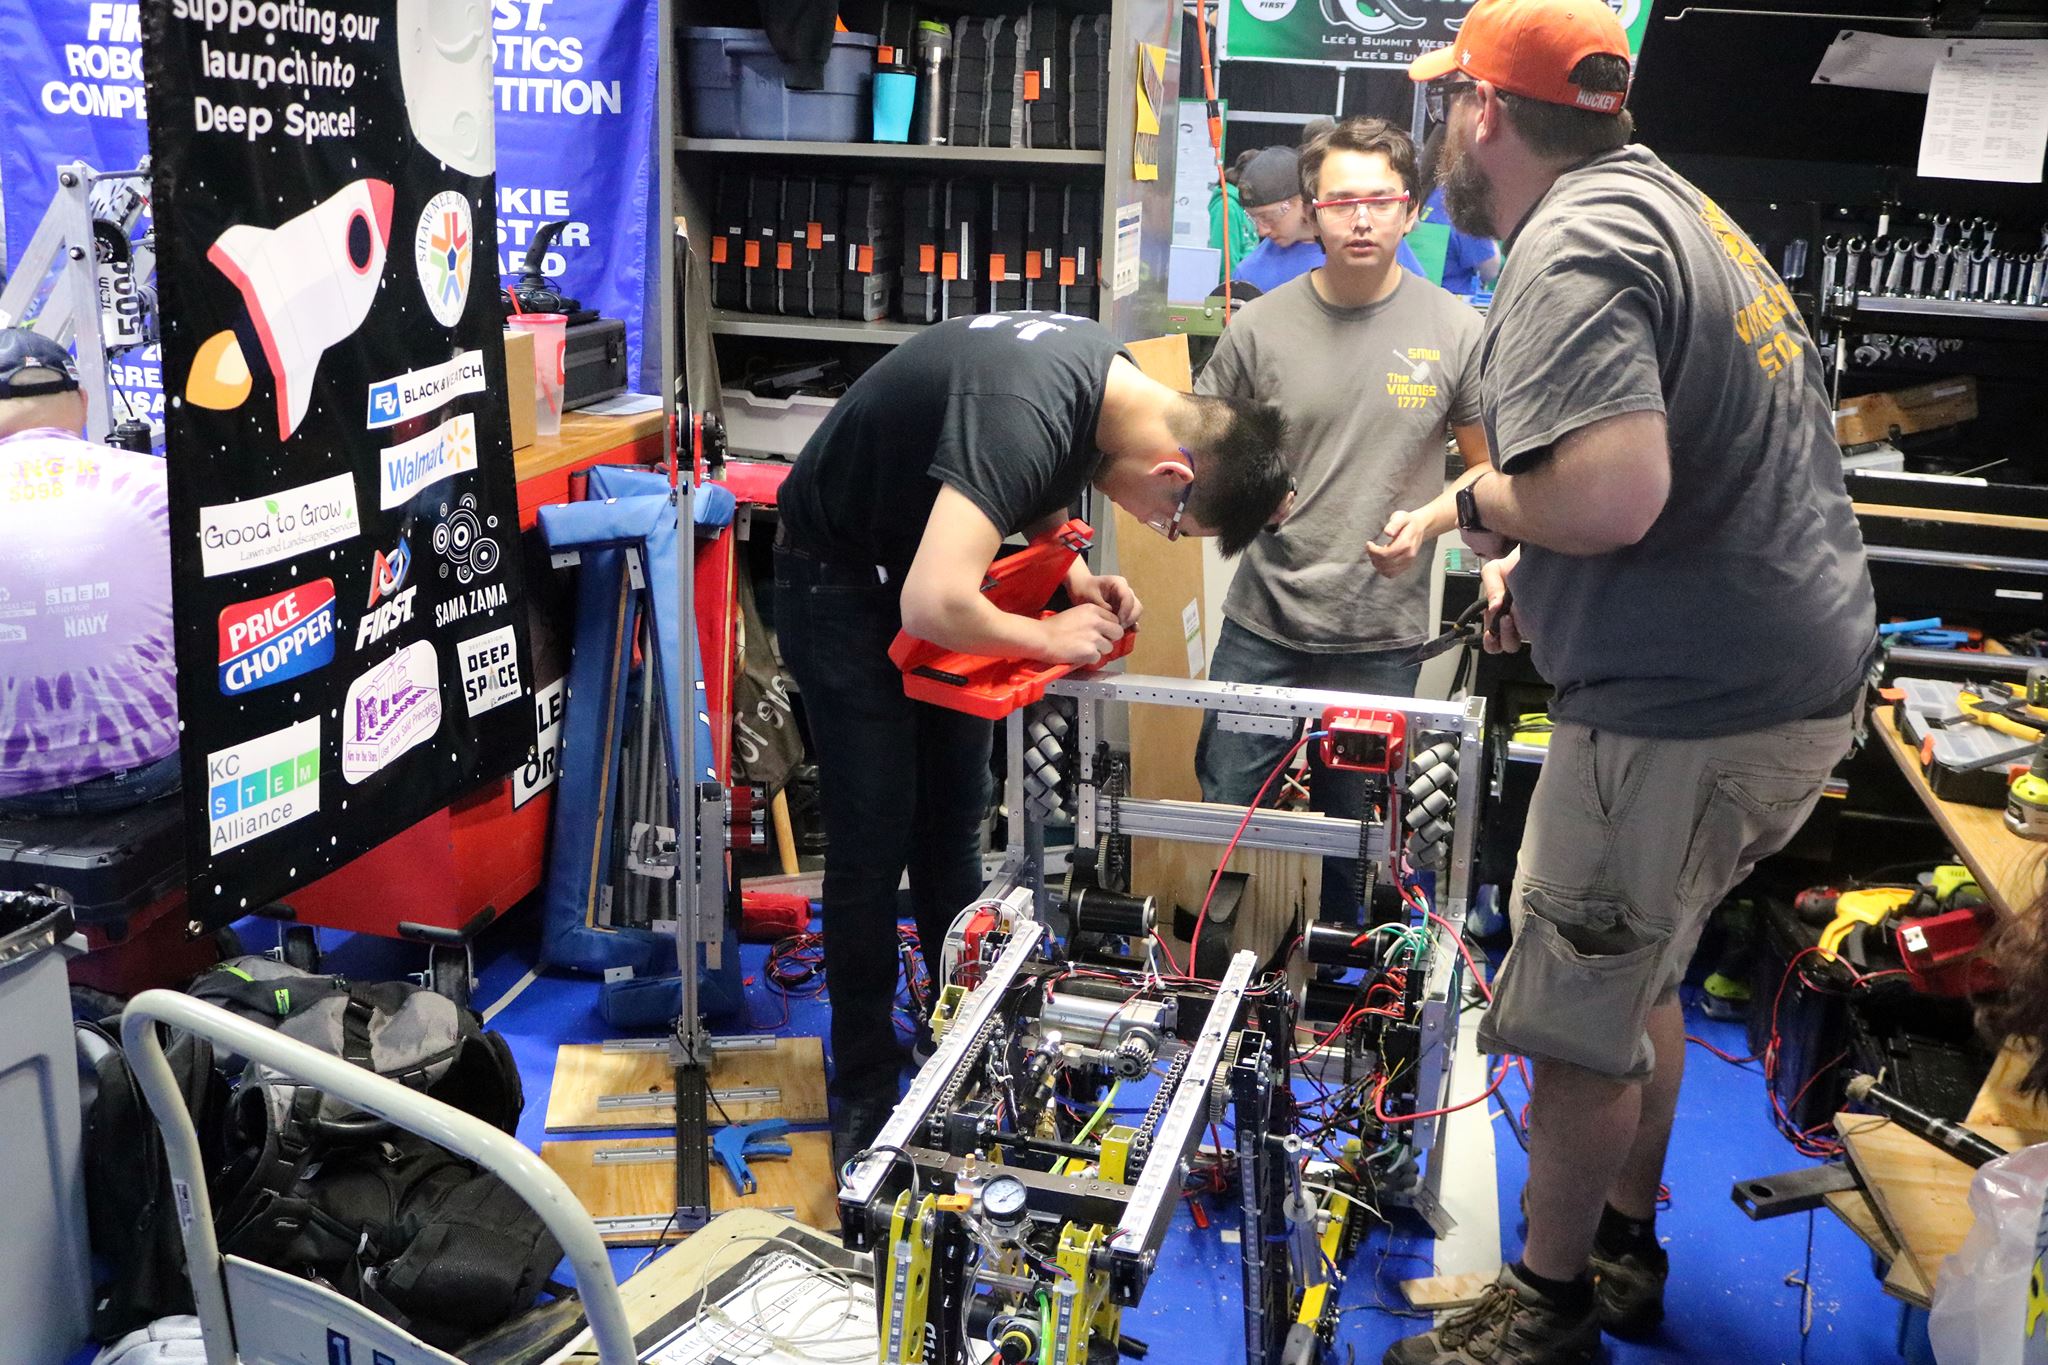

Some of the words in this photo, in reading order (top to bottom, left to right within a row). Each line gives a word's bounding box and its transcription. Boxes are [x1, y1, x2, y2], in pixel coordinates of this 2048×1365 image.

[172, 0, 336, 45] supporting
[341, 13, 380, 42] our
[492, 35, 584, 73] TICS
[1353, 49, 1388, 61] LEE'S
[1361, 36, 1413, 48] SUMMIT
[1417, 38, 1454, 49] WEST
[201, 40, 309, 84] launch
[311, 52, 356, 88] into
[494, 77, 622, 114] TITION
[1576, 90, 1617, 110] HOCKEY
[194, 96, 272, 141] Deep
[283, 103, 356, 144] Space!
[495, 187, 570, 216] KIE
[1407, 347, 1441, 361] SMW
[404, 381, 440, 403] BLACK
[446, 364, 483, 389] VEATCH
[1386, 372, 1410, 384] The
[1386, 383, 1437, 397] VIKINGS
[1397, 396, 1427, 408] 1777
[388, 436, 445, 492] Walmart
[204, 513, 271, 549] Good
[276, 511, 296, 533] to
[300, 500, 342, 527] Grow
[228, 592, 300, 653] PRICE
[355, 585, 417, 651] FIRST
[435, 595, 468, 628] SAMA
[469, 583, 508, 614] ZAMA
[63, 612, 109, 638] NAVY
[225, 610, 332, 690] CHOPPER
[467, 643, 509, 672] DEEP
[210, 754, 241, 782] KC
[215, 764, 312, 814] STEM
[213, 803, 293, 847] Alliance
